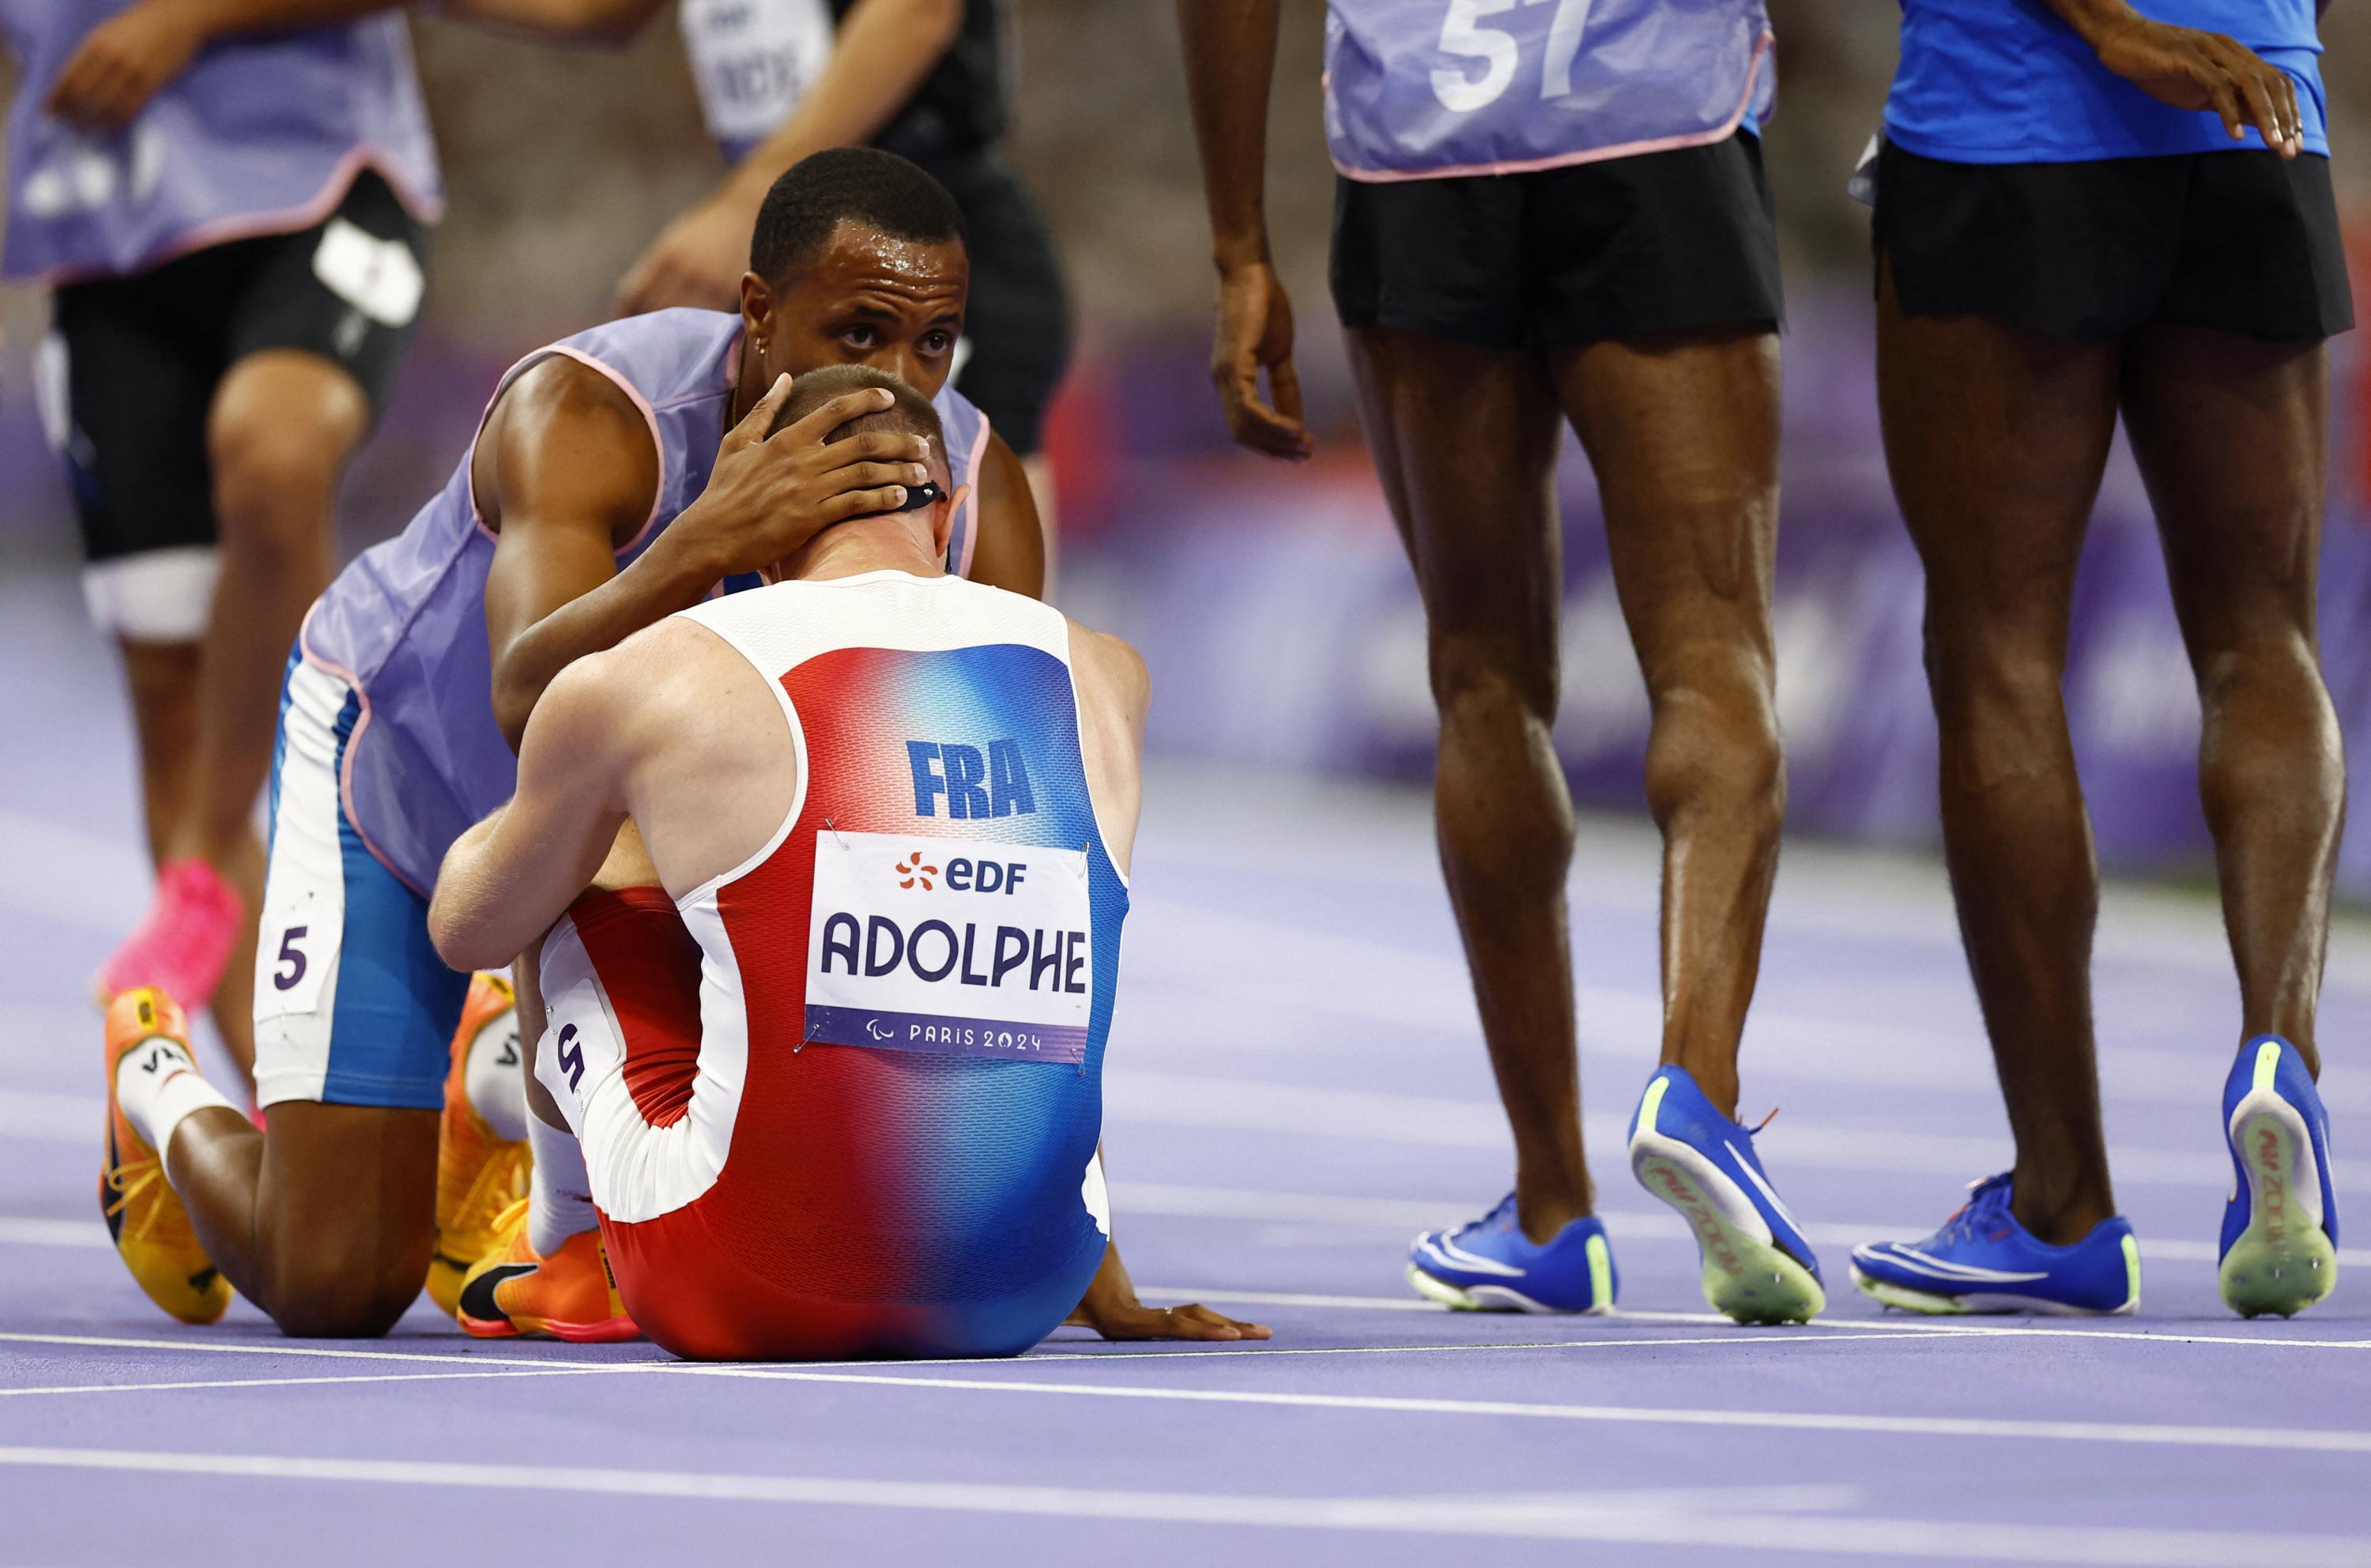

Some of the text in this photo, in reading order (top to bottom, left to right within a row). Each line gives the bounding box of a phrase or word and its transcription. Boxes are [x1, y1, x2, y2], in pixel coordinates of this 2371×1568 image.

[1430, 0, 1592, 112] 57
[906, 738, 1036, 820] FRA
[274, 925, 308, 990] 5
[820, 911, 1086, 994] ADOLPHE
[557, 1023, 586, 1095] 5
[983, 1031, 1042, 1051] 2024
